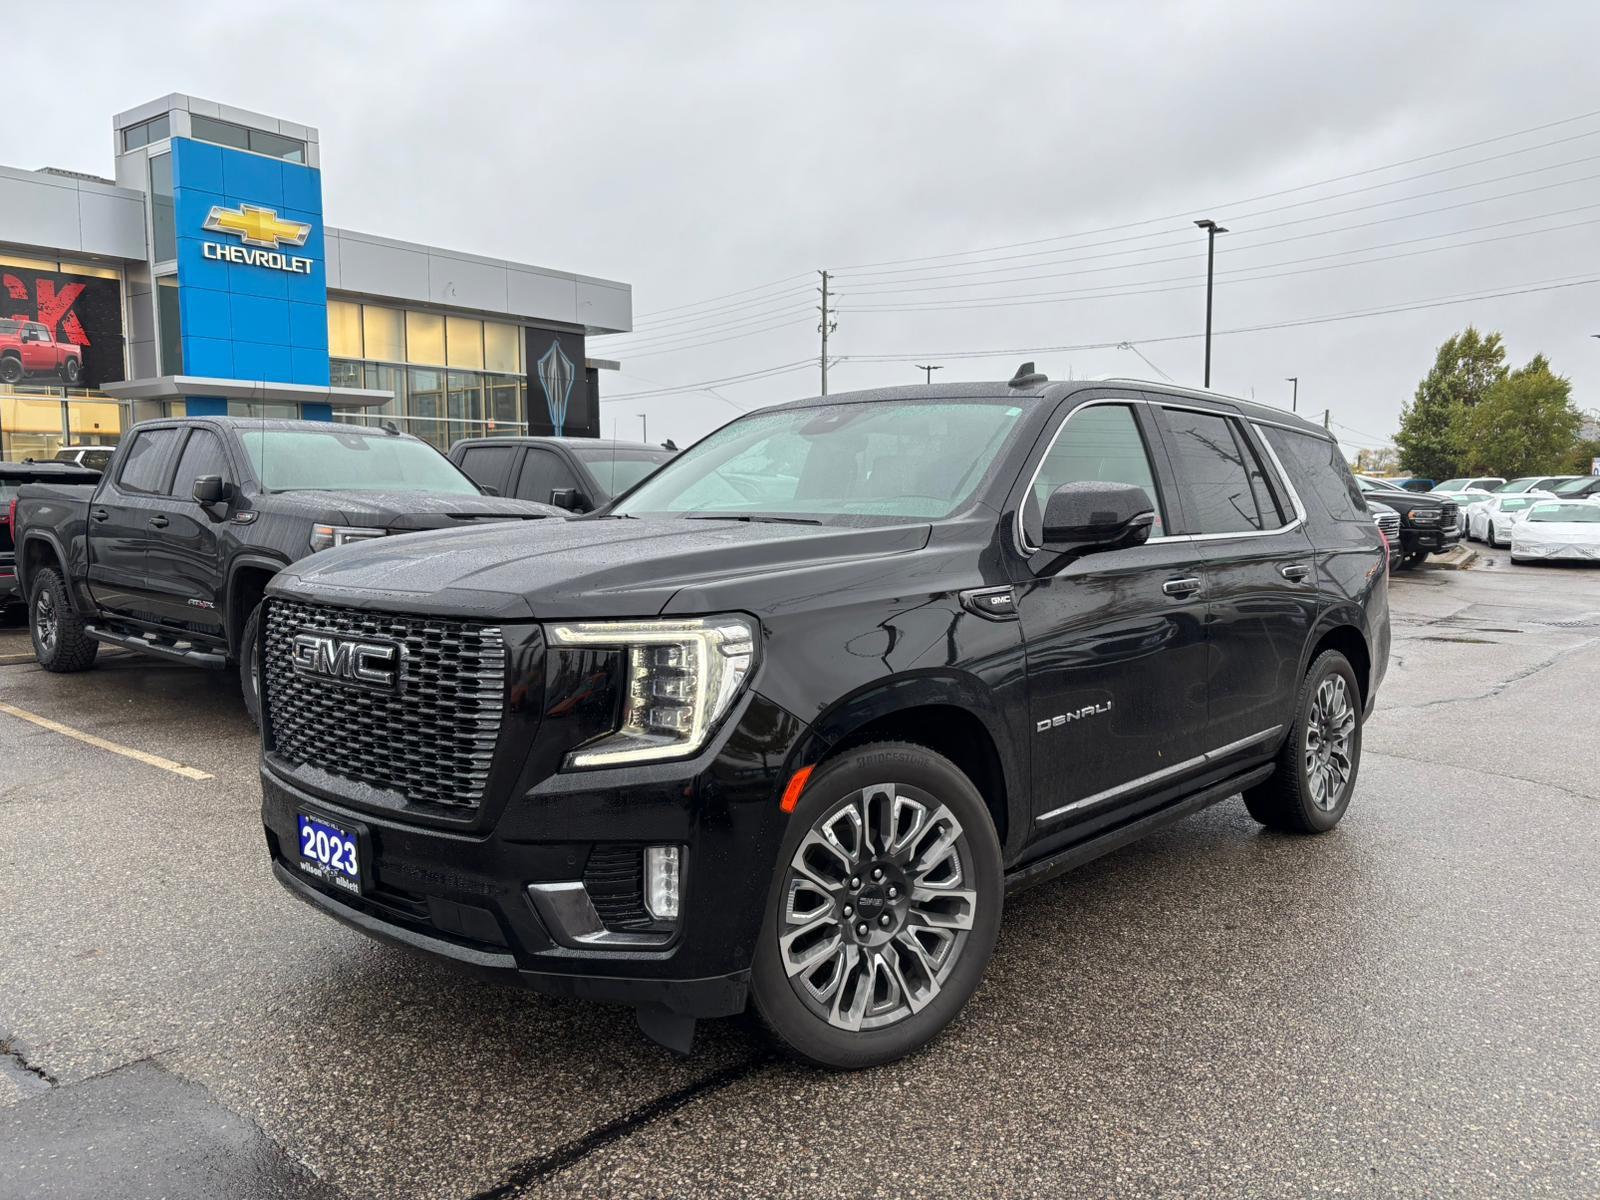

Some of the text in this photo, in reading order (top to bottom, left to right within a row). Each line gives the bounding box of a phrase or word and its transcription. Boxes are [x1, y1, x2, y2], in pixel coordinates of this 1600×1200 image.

[203, 242, 314, 274] CHEVROLET
[991, 595, 1011, 604] GMC
[292, 634, 394, 685] GMC
[1037, 701, 1111, 732] DENALI
[302, 825, 358, 876] 2023
[300, 861, 359, 893] wilson niblett
